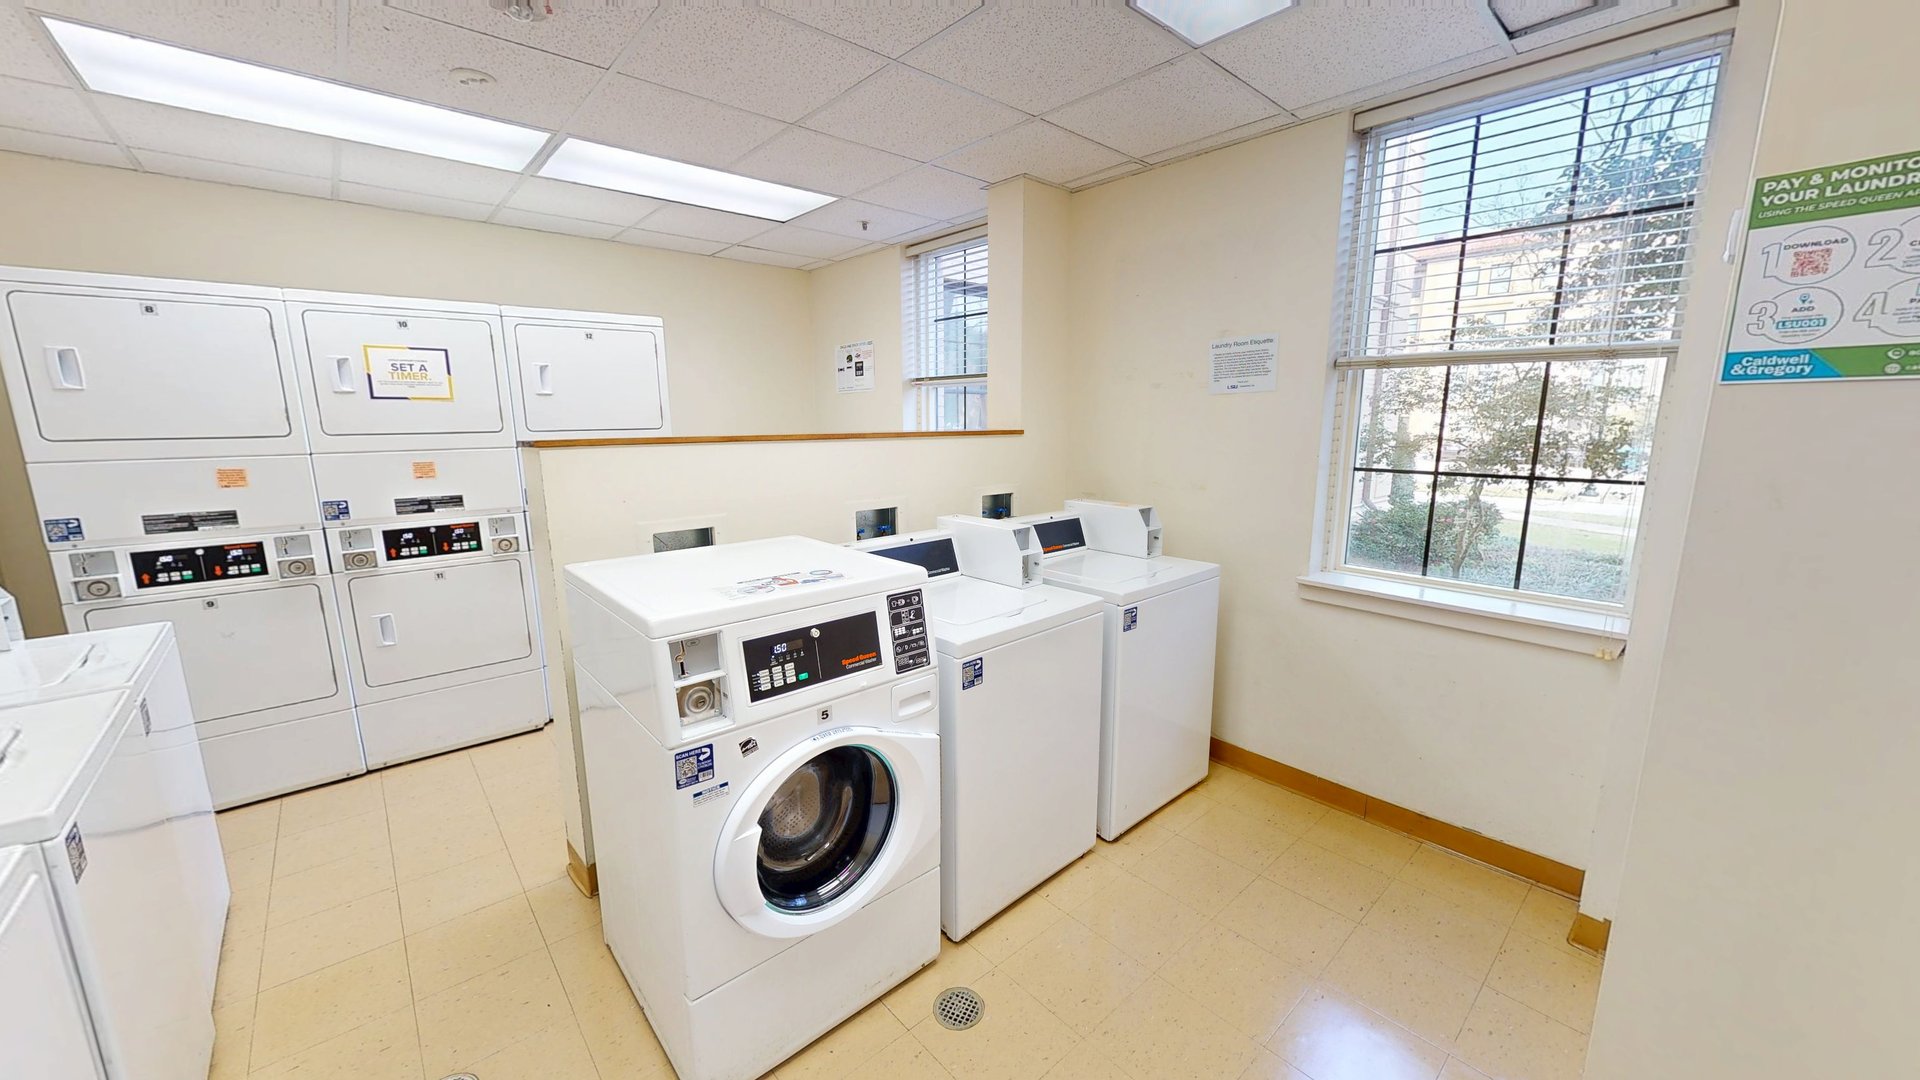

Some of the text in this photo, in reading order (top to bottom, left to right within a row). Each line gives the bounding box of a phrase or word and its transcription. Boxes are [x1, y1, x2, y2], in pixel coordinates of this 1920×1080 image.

[1763, 176, 1805, 193] PAY
[1809, 173, 1824, 186] &
[1761, 188, 1819, 207] YOUR
[1758, 207, 1791, 219] USING
[1794, 204, 1815, 213] THE
[1818, 198, 1856, 209] SPEED
[1859, 191, 1902, 204] QUEEN
[1783, 237, 1849, 250] DOWNLOAD
[1864, 228, 1904, 268] 2
[1761, 242, 1783, 278] 1
[1791, 305, 1815, 313] ADD
[1852, 291, 1888, 329] 4
[1746, 300, 1778, 337] 3
[1777, 318, 1826, 329] LSU001
[1211, 342, 1232, 350] Laundry
[1249, 338, 1274, 346] Etiquette
[1741, 353, 1810, 367] Caldwell
[390, 363, 428, 372] SET A
[1730, 363, 1813, 376] &Gregory
[388, 371, 432, 381] TIMER.
[206, 600, 214, 608] 9
[841, 651, 877, 666] Speed Queen
[846, 660, 867, 670] Commercial
[821, 709, 829, 720] 5
